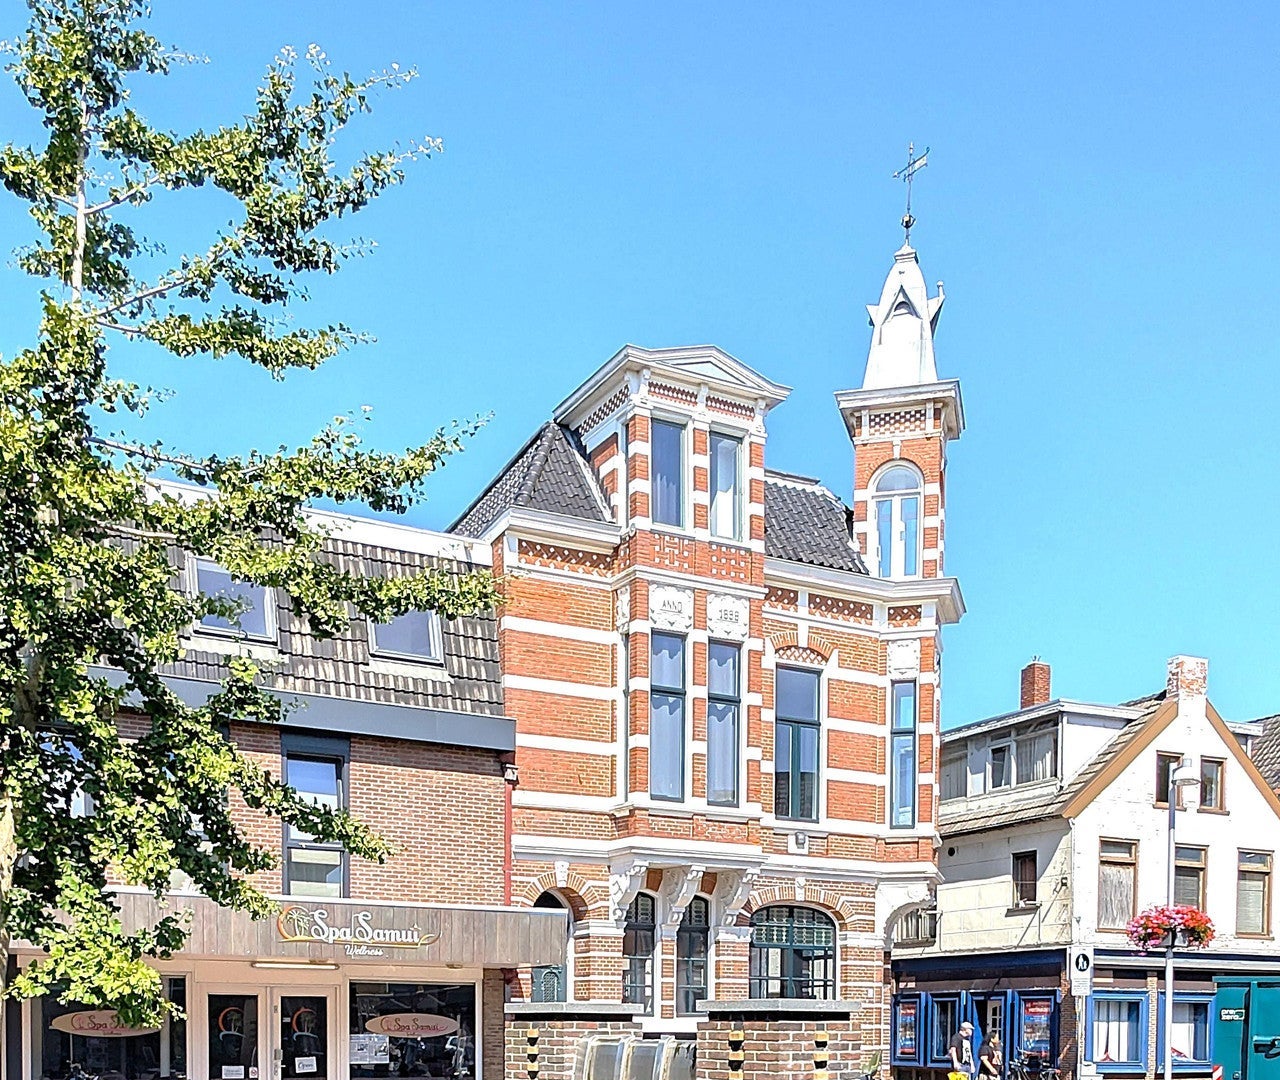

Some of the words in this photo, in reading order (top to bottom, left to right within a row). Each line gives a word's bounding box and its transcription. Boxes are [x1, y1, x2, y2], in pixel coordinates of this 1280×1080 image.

[662, 600, 683, 613] ANNO
[310, 910, 352, 944] Spa
[353, 911, 420, 943] Samui
[344, 944, 384, 957] Wellness
[394, 1018, 410, 1031] Spa
